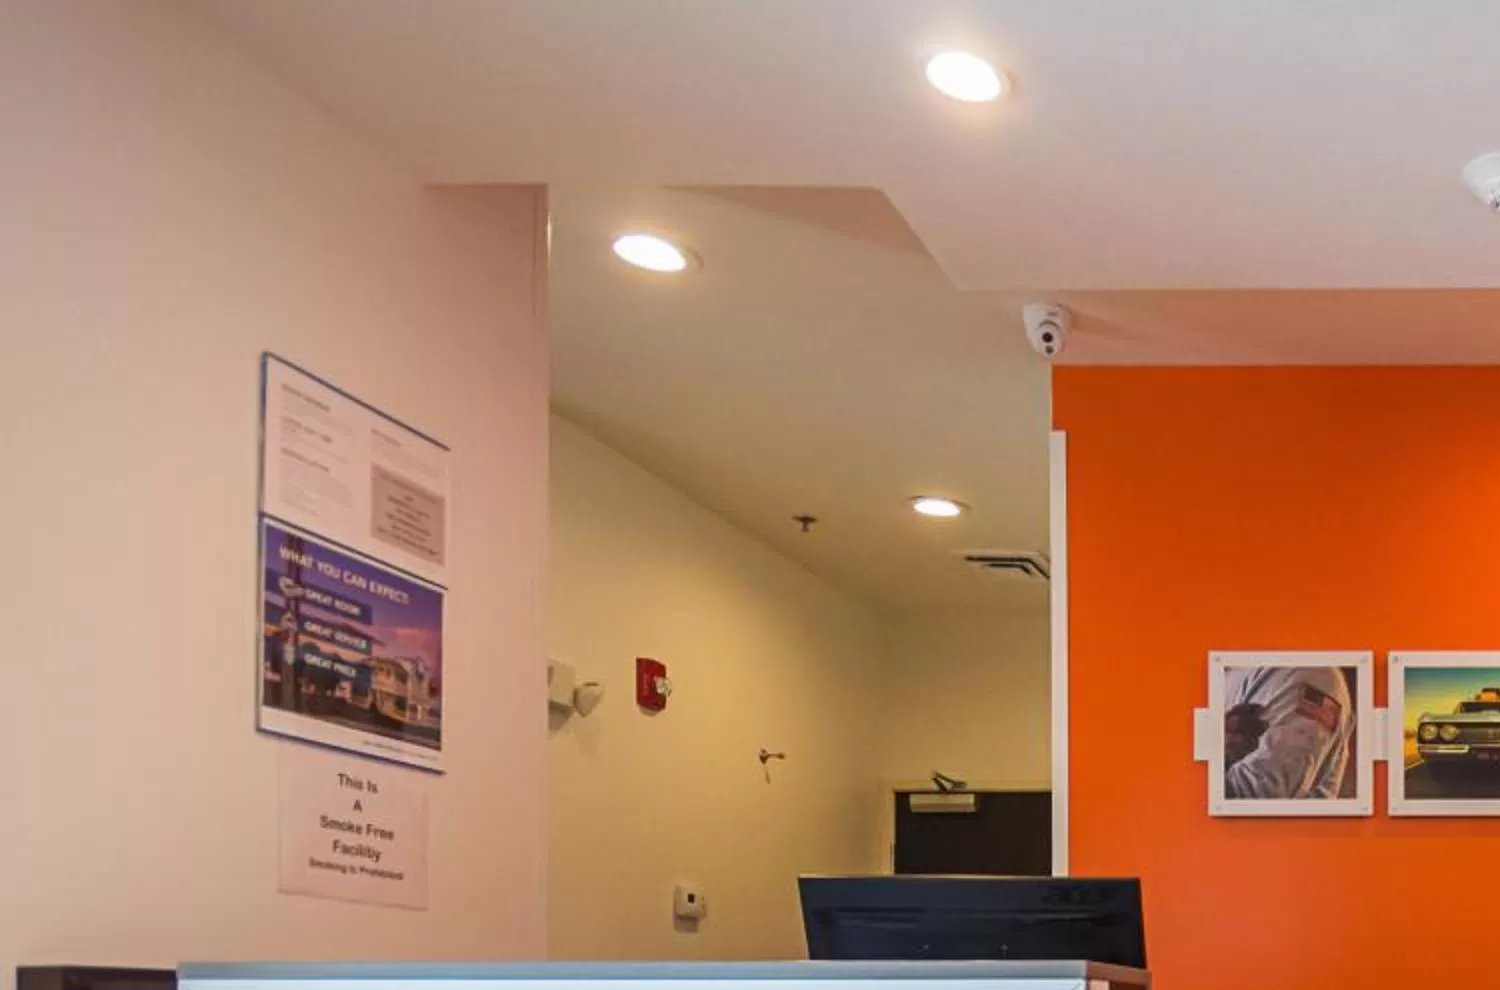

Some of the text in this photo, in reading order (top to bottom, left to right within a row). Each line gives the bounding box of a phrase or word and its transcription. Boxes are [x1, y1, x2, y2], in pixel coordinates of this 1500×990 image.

[316, 561, 341, 579] YOU
[343, 570, 367, 590] CAN
[337, 773, 364, 790] This
[353, 799, 363, 812] A
[320, 815, 395, 841] Smoke Free
[332, 839, 382, 863] Facility
